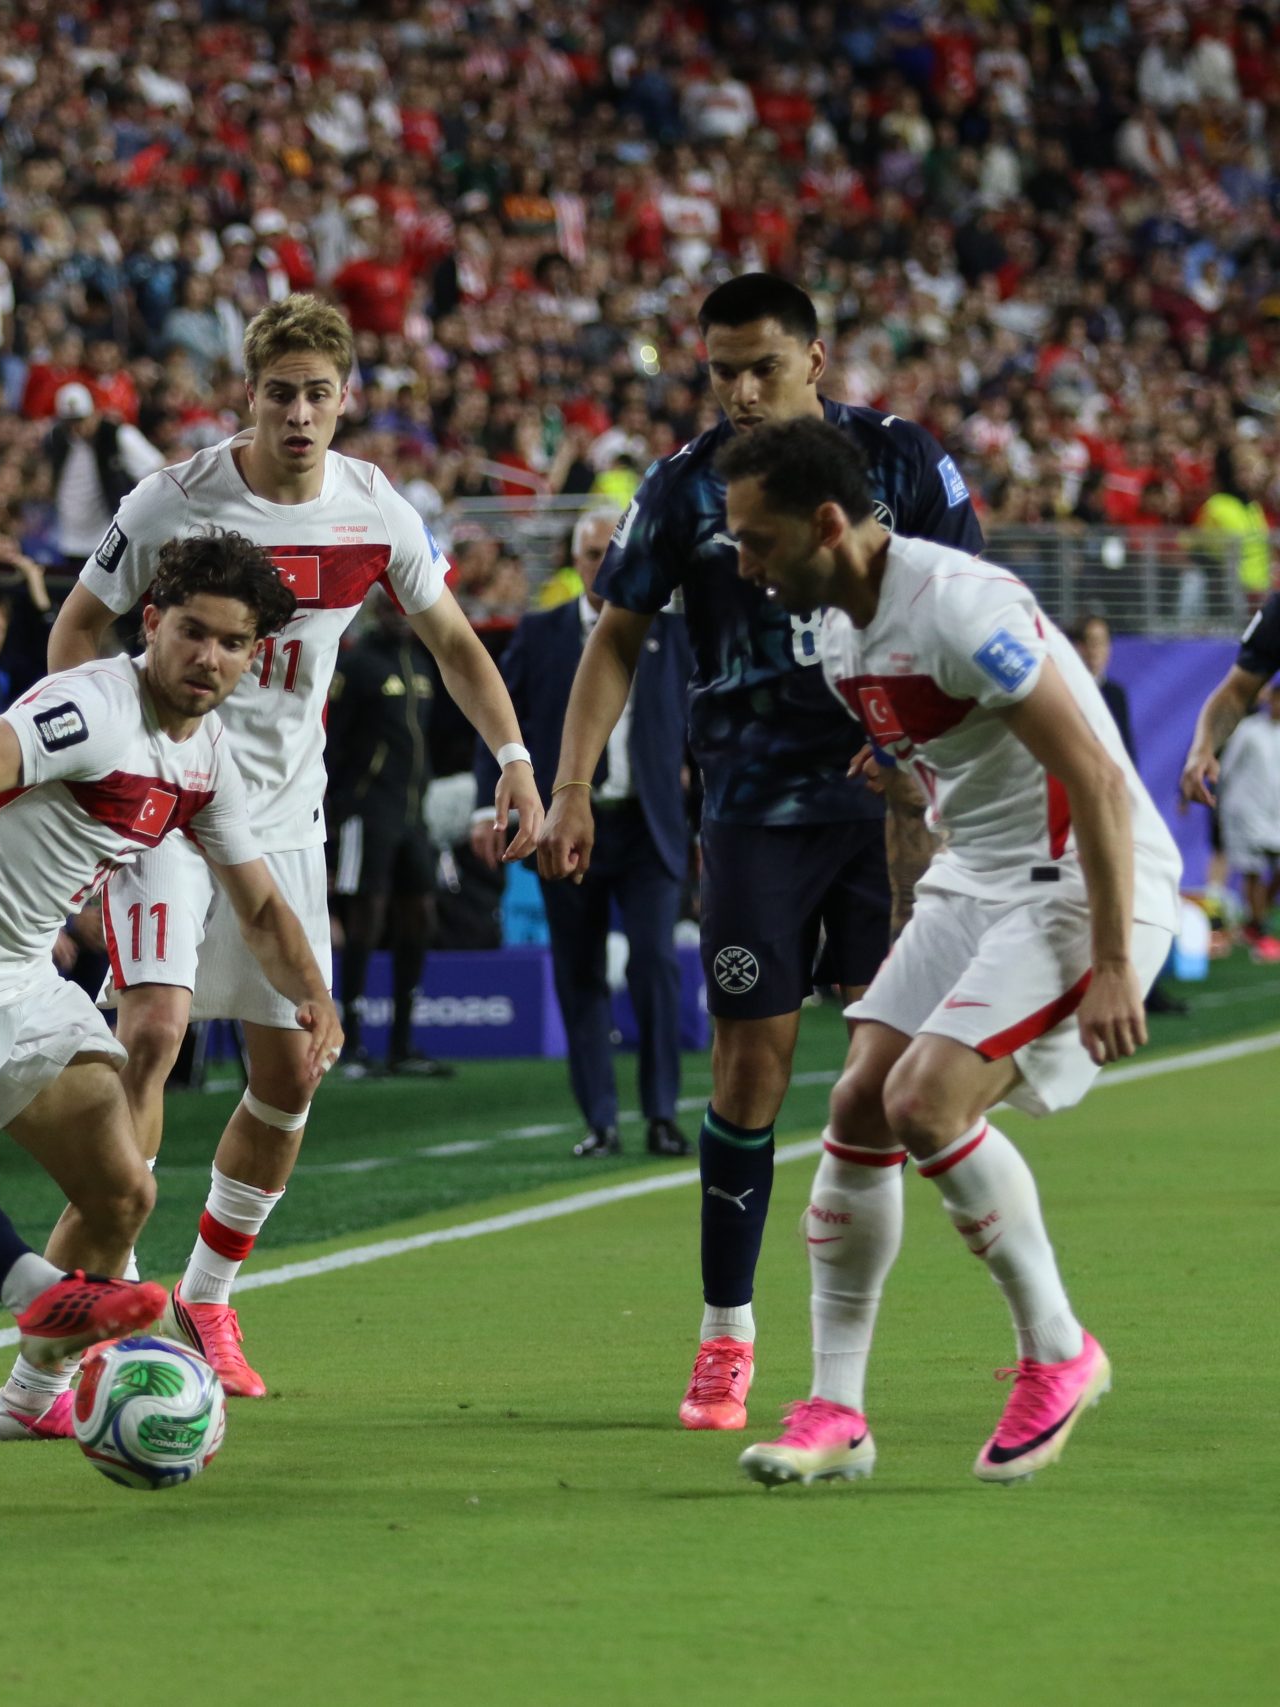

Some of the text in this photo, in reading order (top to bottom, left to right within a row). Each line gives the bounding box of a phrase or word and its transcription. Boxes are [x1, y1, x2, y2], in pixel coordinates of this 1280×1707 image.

[256, 636, 303, 693] 11
[127, 902, 169, 962] 11
[727, 950, 743, 959] APF
[148, 1438, 194, 1449] TRIONDA
